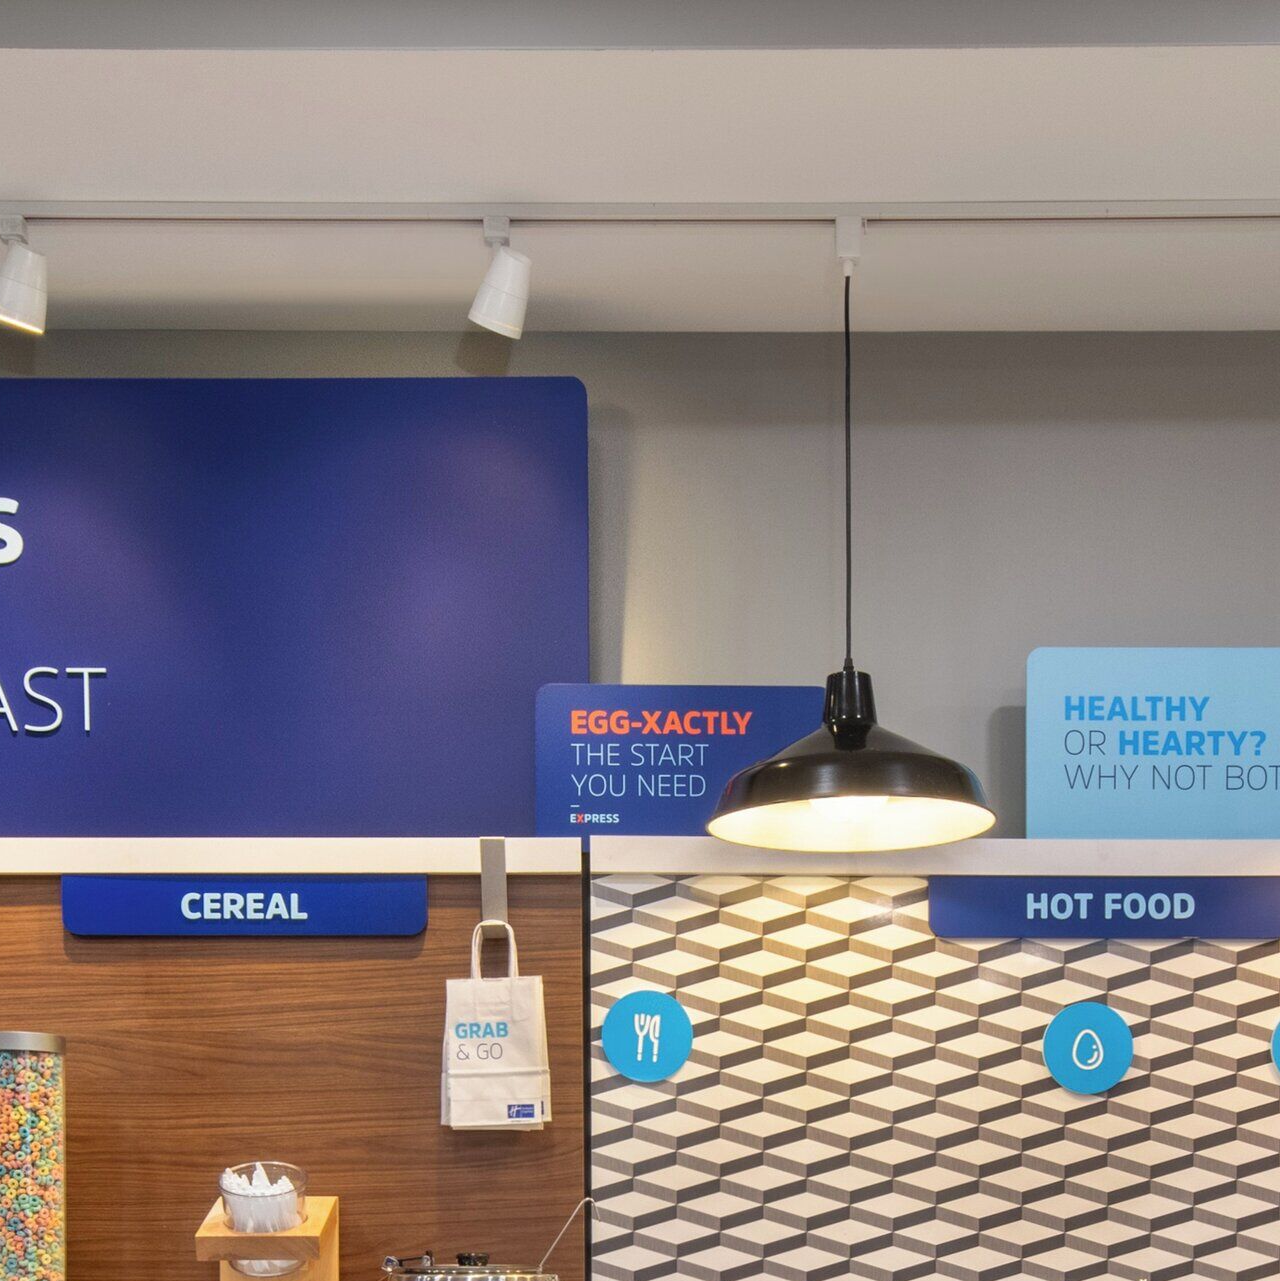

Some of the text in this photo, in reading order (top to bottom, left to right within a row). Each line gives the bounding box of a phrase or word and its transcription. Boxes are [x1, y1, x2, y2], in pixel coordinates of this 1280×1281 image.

[1064, 695, 1210, 722] HEALTHY
[570, 710, 753, 735] EGG-XACTLY
[570, 743, 710, 767] THE START
[1063, 729, 1267, 756] OR HEARTY?
[571, 774, 707, 797] YOU NEED
[1064, 764, 1139, 790] WHY
[1151, 764, 1213, 790] NOT
[570, 813, 620, 824] EXPRESS
[180, 892, 308, 920] CEREAL
[1026, 892, 1196, 920] HOT FOOD
[454, 1021, 509, 1039] GRAB
[456, 1042, 503, 1061] & GO
